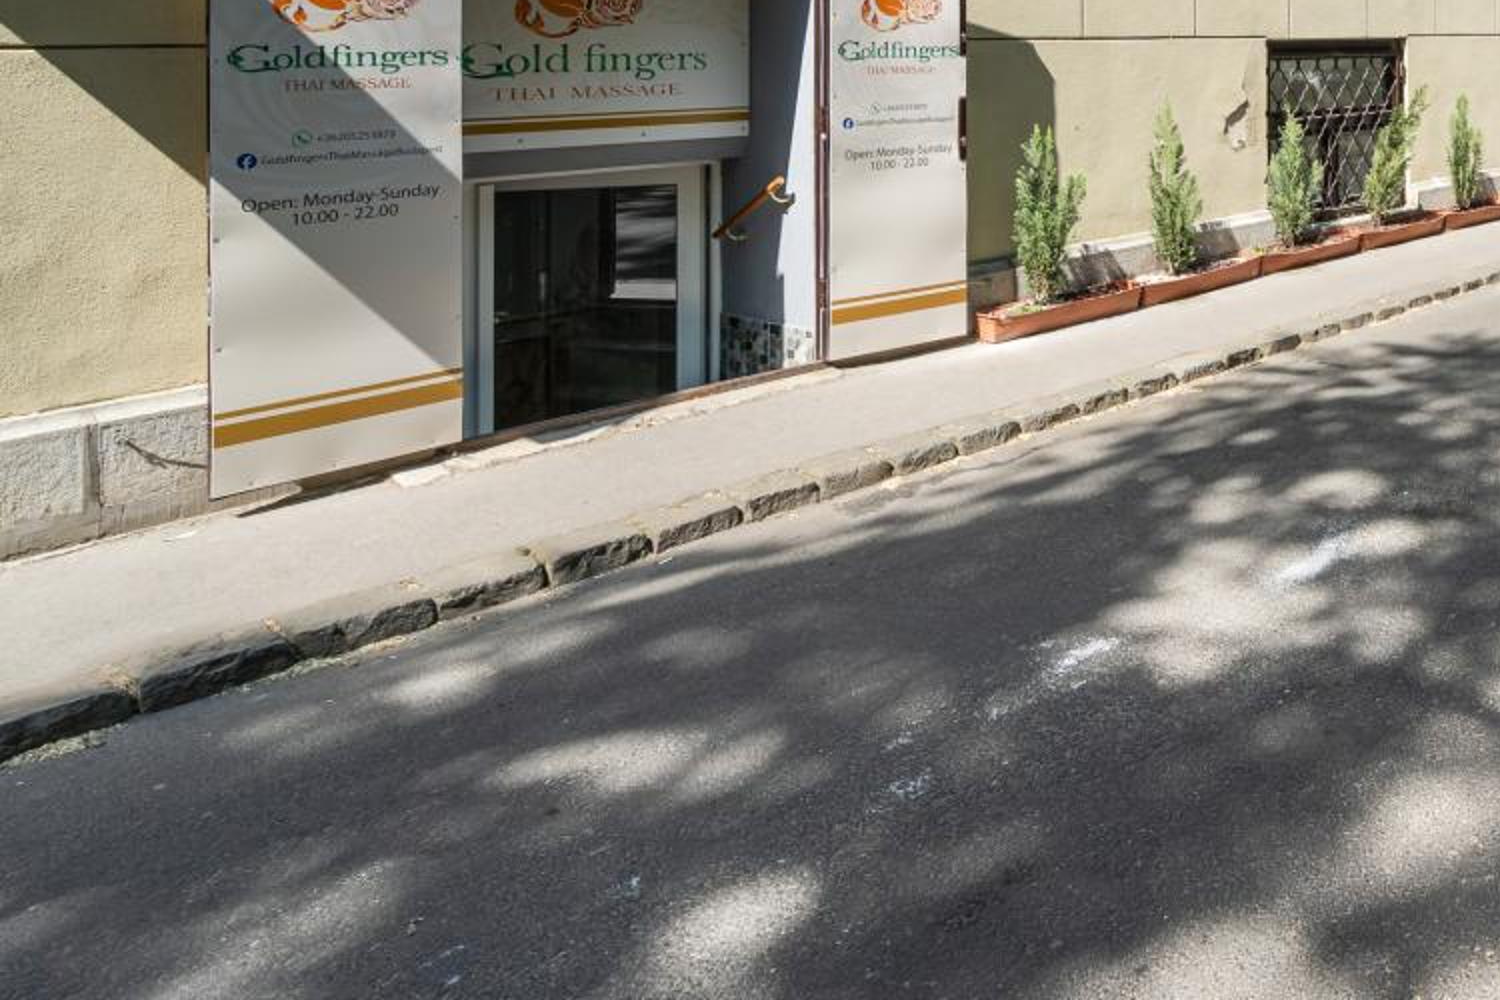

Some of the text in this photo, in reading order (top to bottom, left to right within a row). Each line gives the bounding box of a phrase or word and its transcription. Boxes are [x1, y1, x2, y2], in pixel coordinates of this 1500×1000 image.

[285, 76, 412, 92] THAI MASSAGE
[495, 83, 682, 102] THAI MASSAGE
[241, 184, 441, 214] Open: Monday-Sunday
[292, 209, 339, 226] 10.00
[355, 203, 399, 220] 22.00
